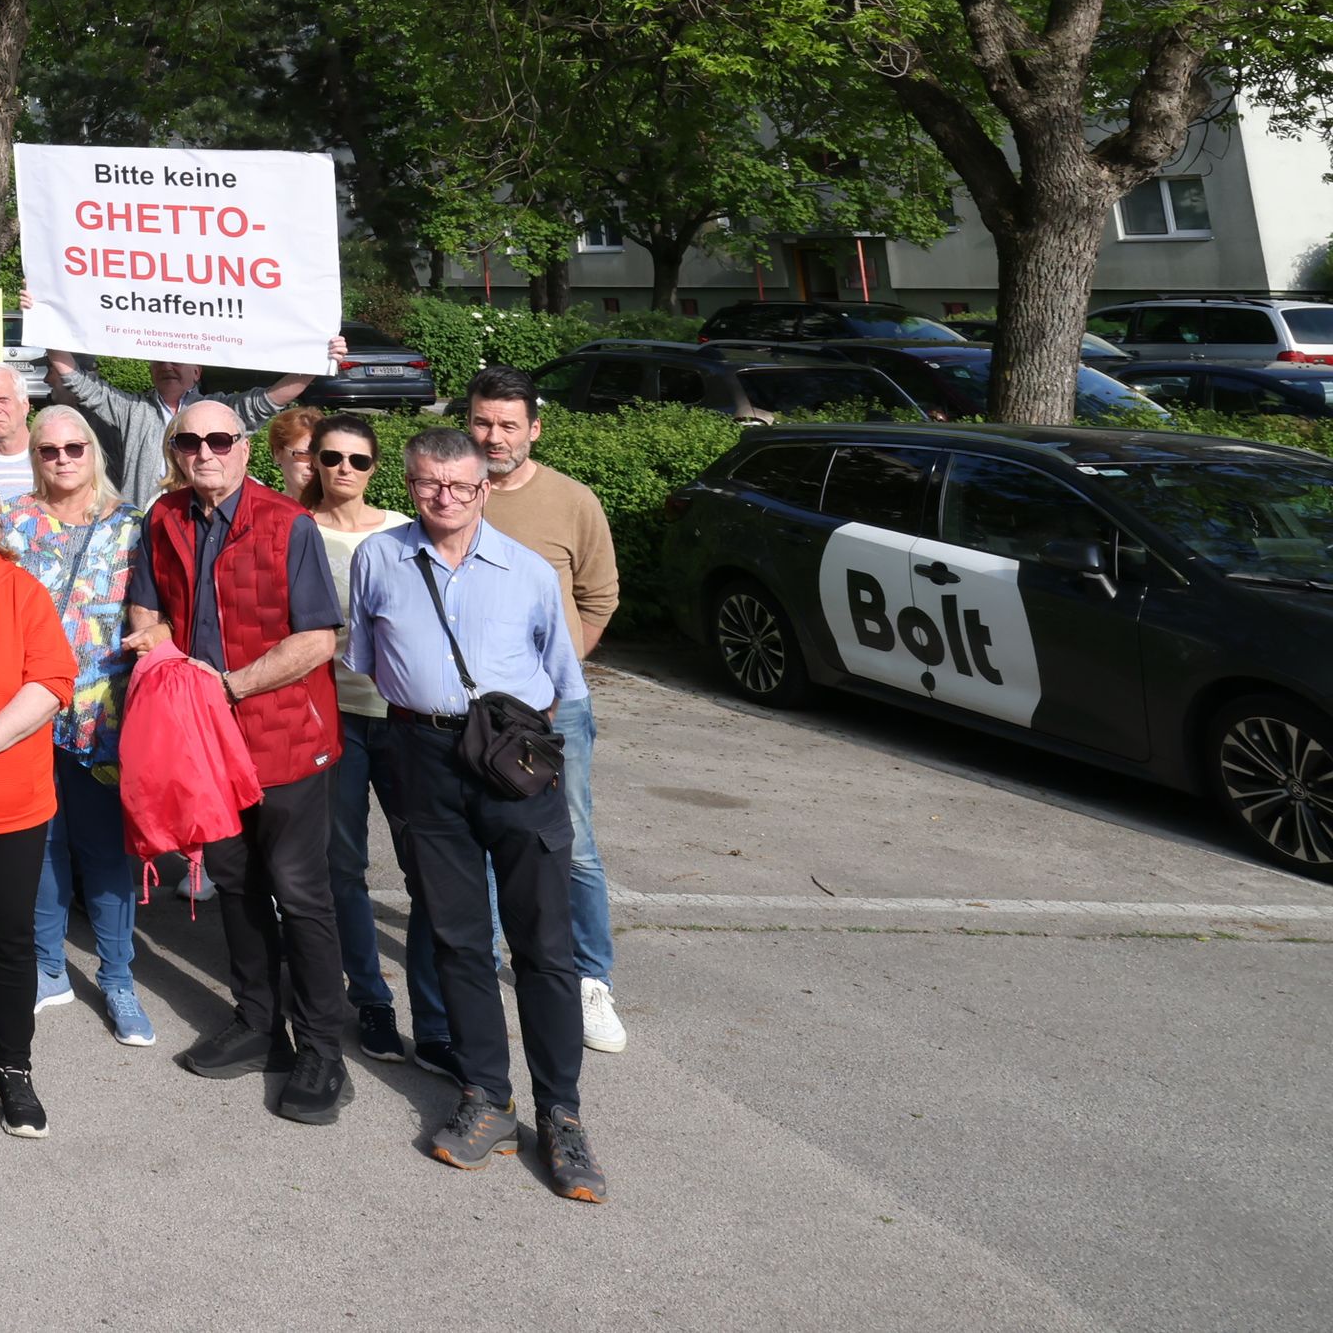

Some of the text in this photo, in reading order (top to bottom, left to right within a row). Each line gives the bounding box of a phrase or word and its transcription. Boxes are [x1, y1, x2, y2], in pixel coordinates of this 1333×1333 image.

[94, 163, 237, 188] Bitte keine
[75, 200, 266, 238] GHETTO-
[64, 246, 282, 289] SIEDLUNG
[100, 292, 243, 319] schaffen!!!
[105, 325, 243, 346] Für eine lebenswerte Siedlung
[135, 338, 212, 352] Autokaderstraße
[845, 568, 1004, 686] Bolt
